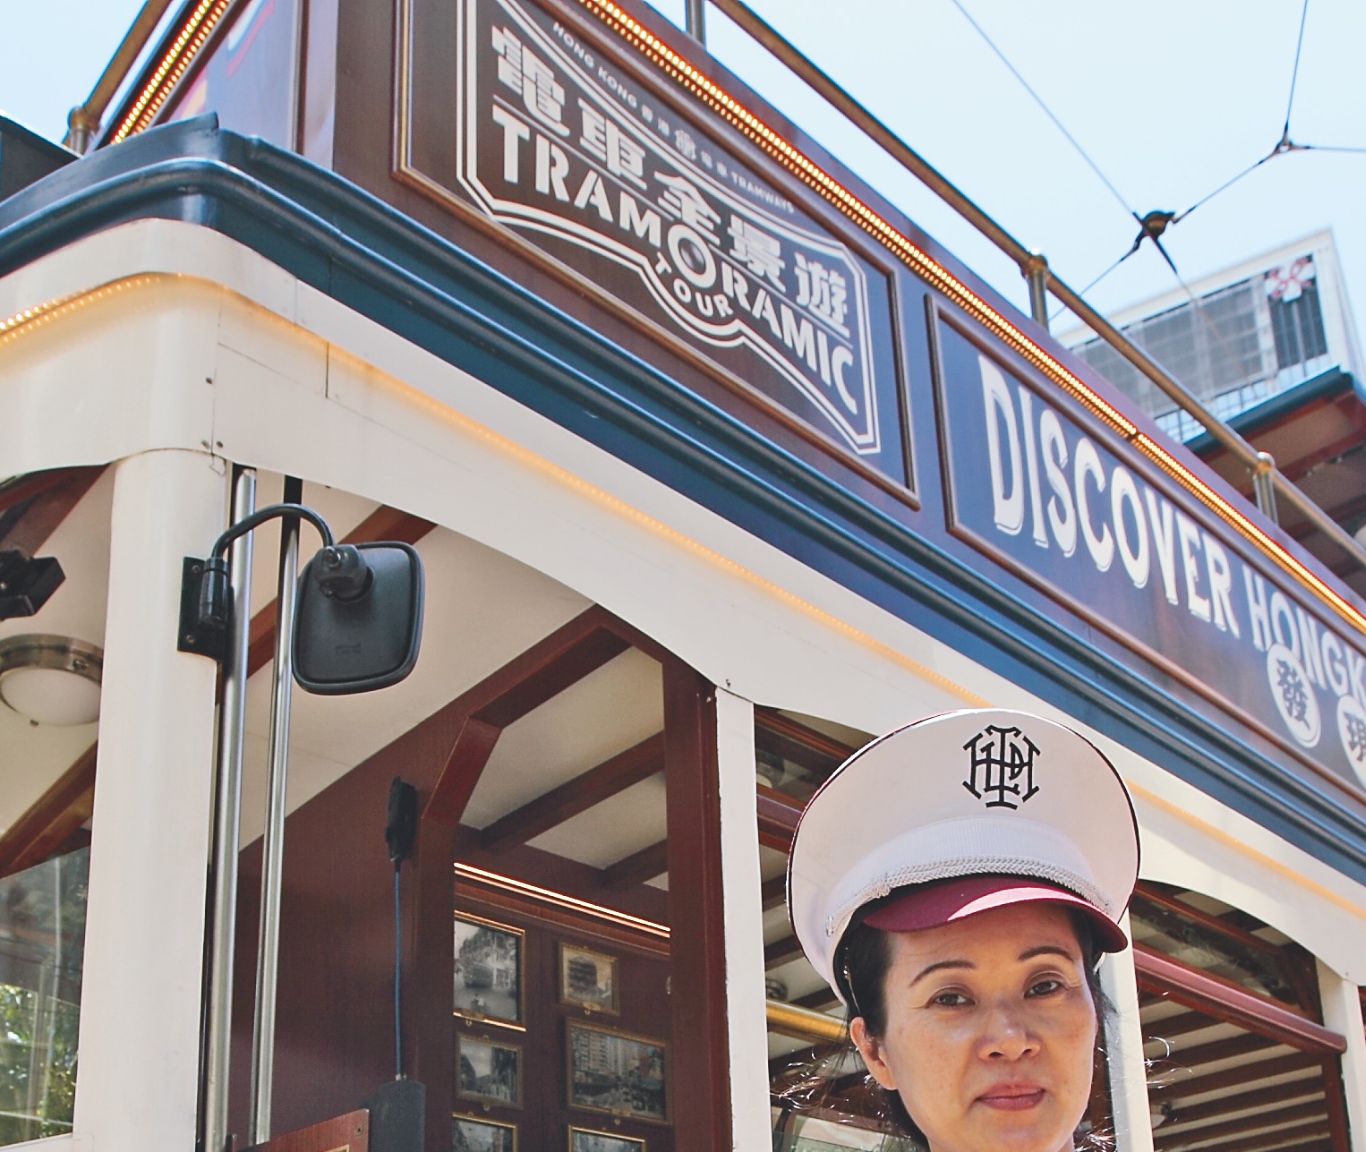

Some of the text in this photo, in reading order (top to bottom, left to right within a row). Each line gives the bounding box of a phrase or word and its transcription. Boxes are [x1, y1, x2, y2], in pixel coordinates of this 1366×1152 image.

[491, 23, 851, 339] 電車全景遊
[492, 103, 858, 416] TRAMORAMIC
[552, 21, 796, 215] HONG KONG TRAMWAYS
[655, 252, 734, 319] TOUR
[978, 353, 1241, 638] DISCOVER
